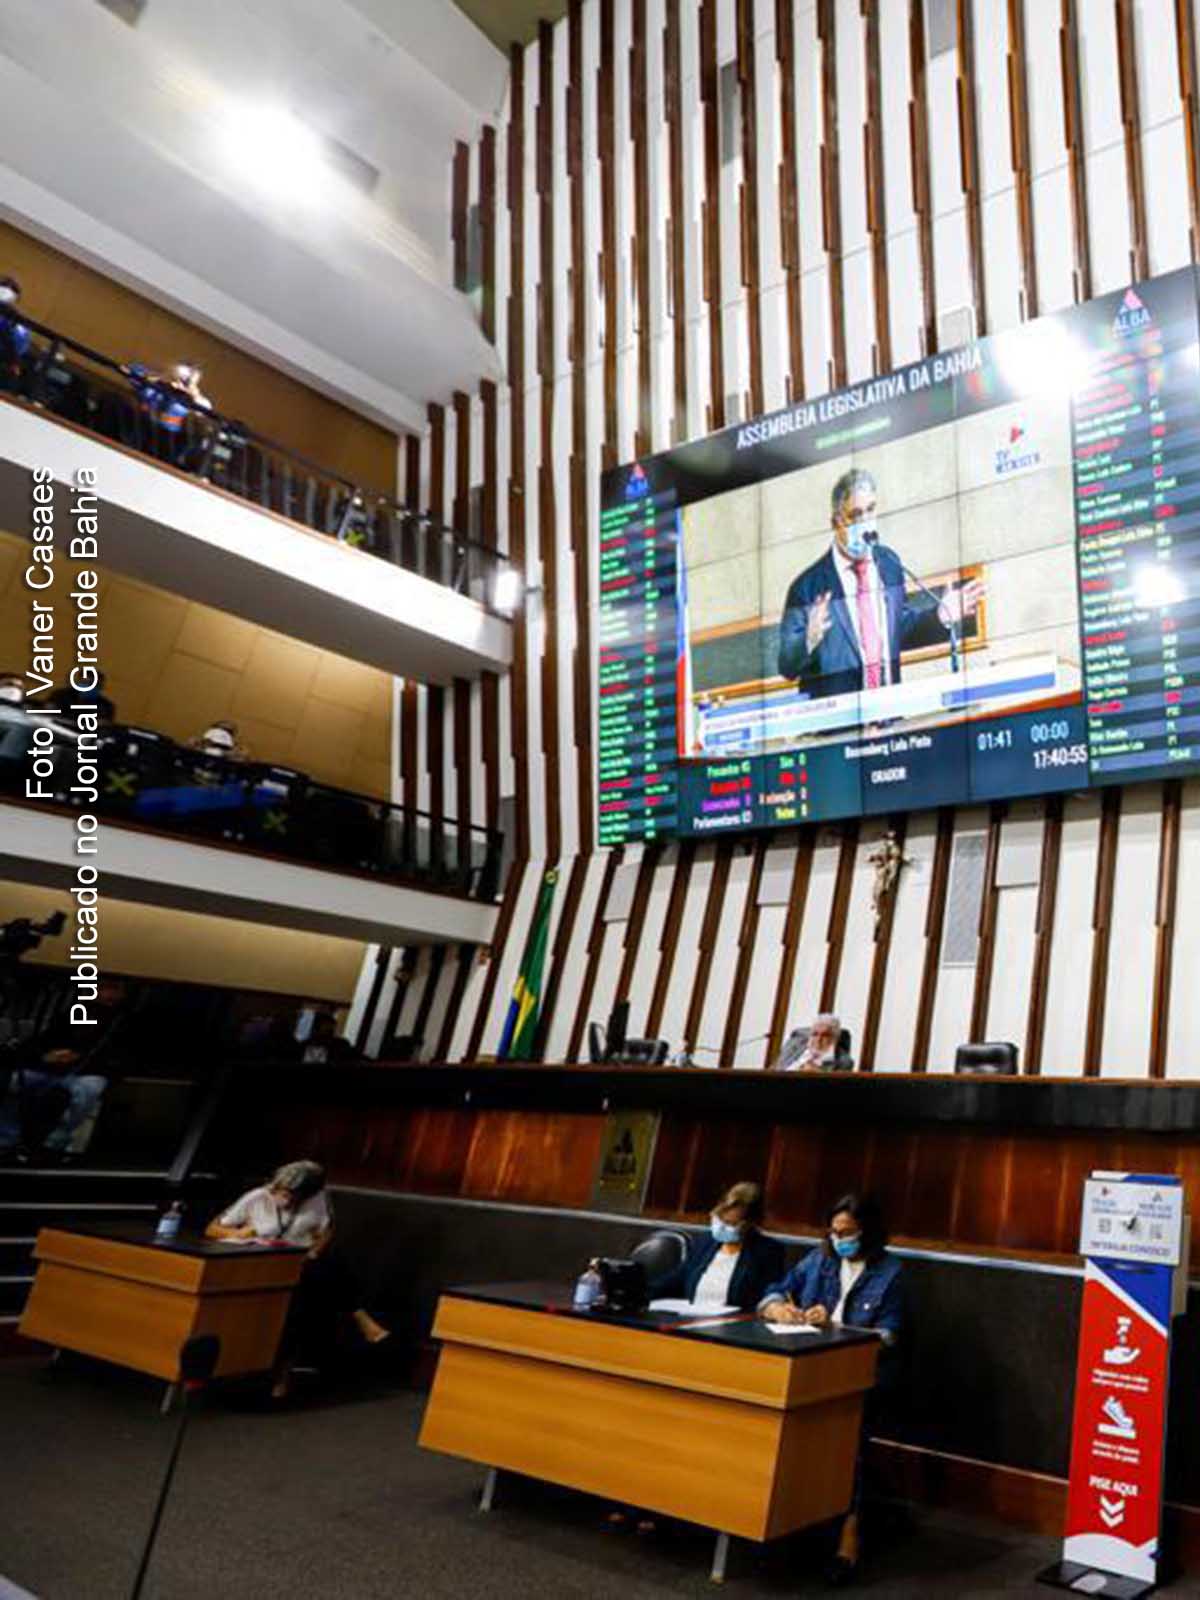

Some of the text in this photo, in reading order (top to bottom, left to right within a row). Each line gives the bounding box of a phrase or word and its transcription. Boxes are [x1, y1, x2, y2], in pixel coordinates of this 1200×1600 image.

[736, 407, 817, 450] ASSEMBLEIA
[819, 374, 907, 422] LEGISLATIVA
[908, 369, 931, 392] DA
[933, 347, 983, 382] BAHIA
[977, 729, 1012, 751] 01:41
[1030, 721, 1070, 743] 00:00
[1033, 744, 1088, 769] 17:40:55
[1112, 1479, 1138, 1497] AQUI
